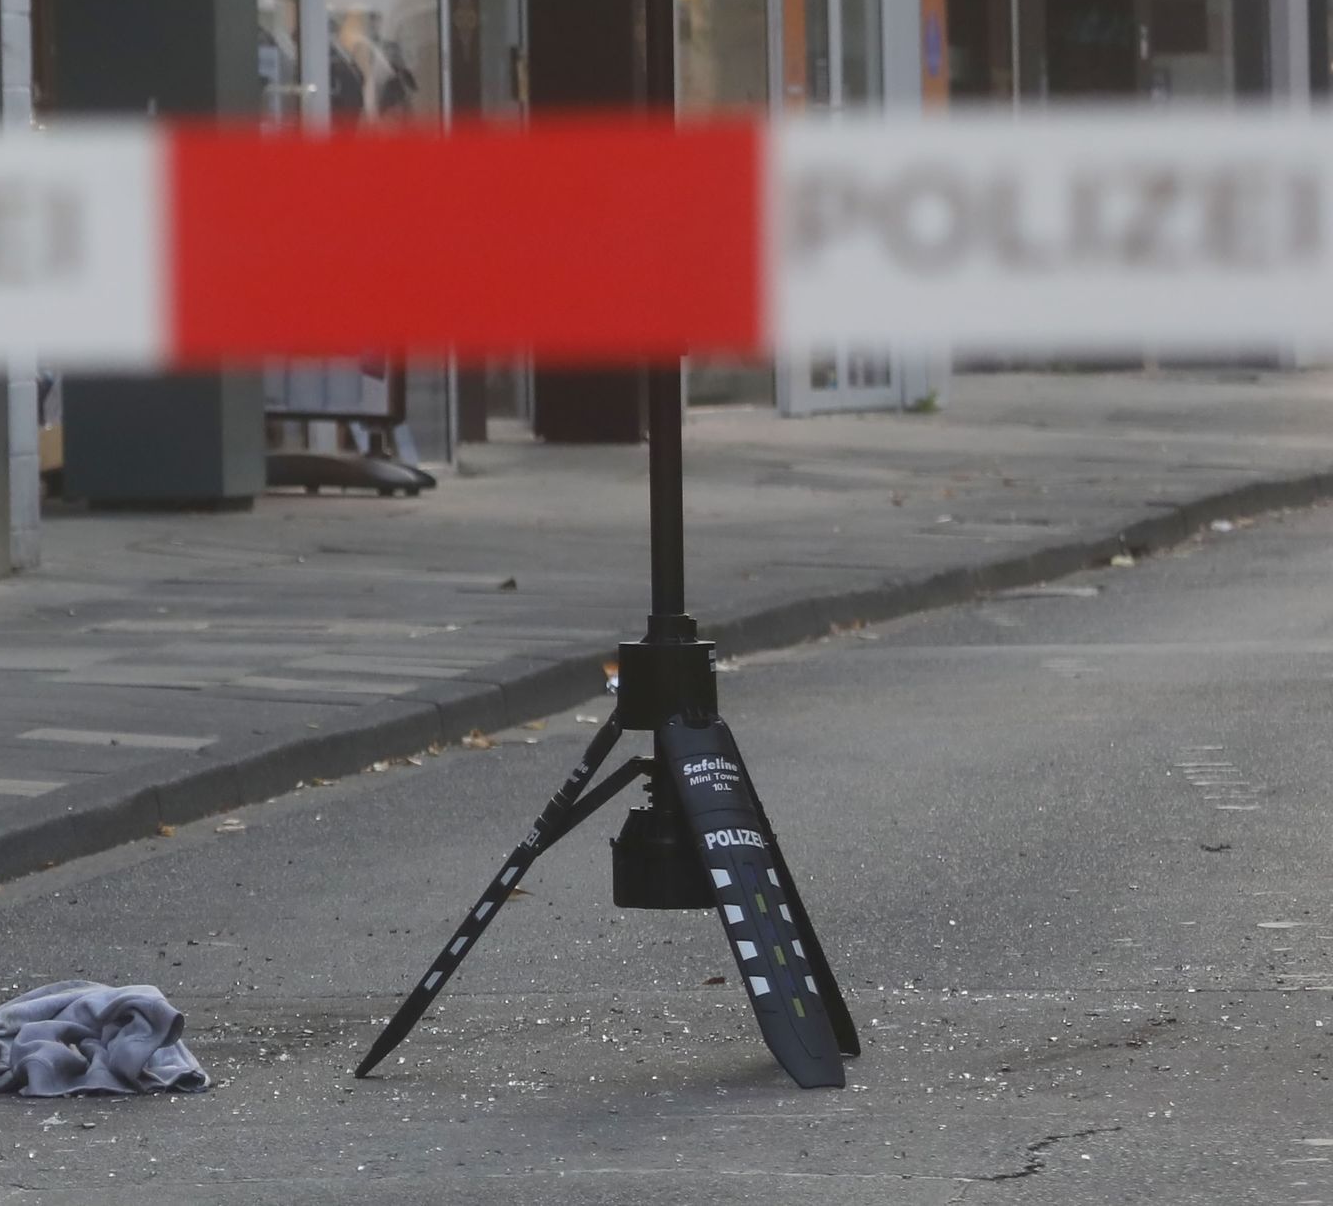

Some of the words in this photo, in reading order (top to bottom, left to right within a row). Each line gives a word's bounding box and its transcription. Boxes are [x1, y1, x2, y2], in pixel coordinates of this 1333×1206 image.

[785, 161, 1322, 278] POLIZEI
[683, 756, 738, 775] Safeline
[689, 773, 711, 786] Mini
[713, 772, 740, 782] Tower
[704, 828, 765, 850] POLIZEI
